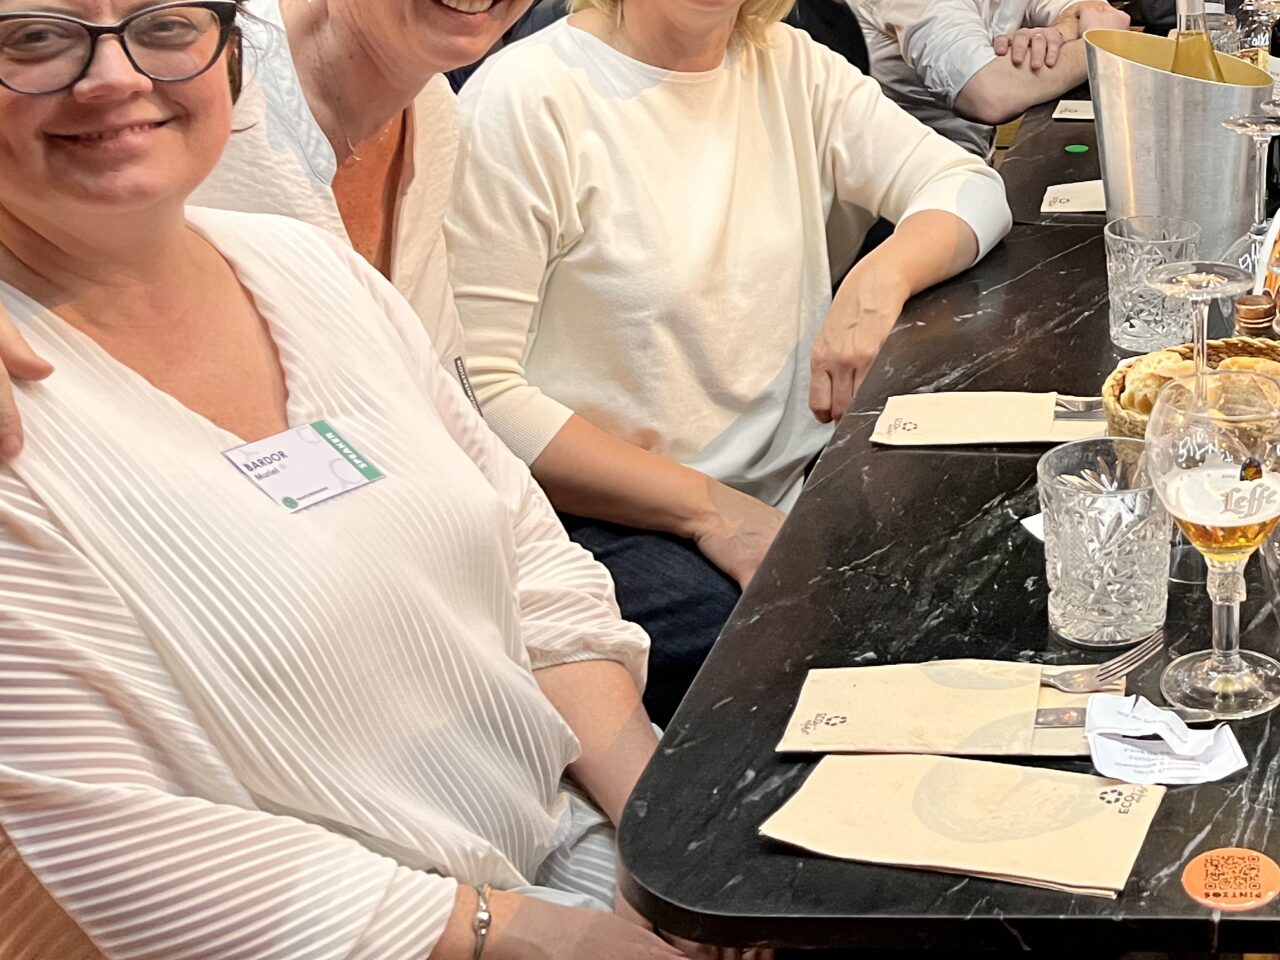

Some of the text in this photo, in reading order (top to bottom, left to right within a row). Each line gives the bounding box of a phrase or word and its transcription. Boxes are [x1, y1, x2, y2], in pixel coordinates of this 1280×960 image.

[325, 432, 368, 470] SPEAKER
[1219, 483, 1278, 519] Leffe
[1118, 795, 1135, 815] ECO
